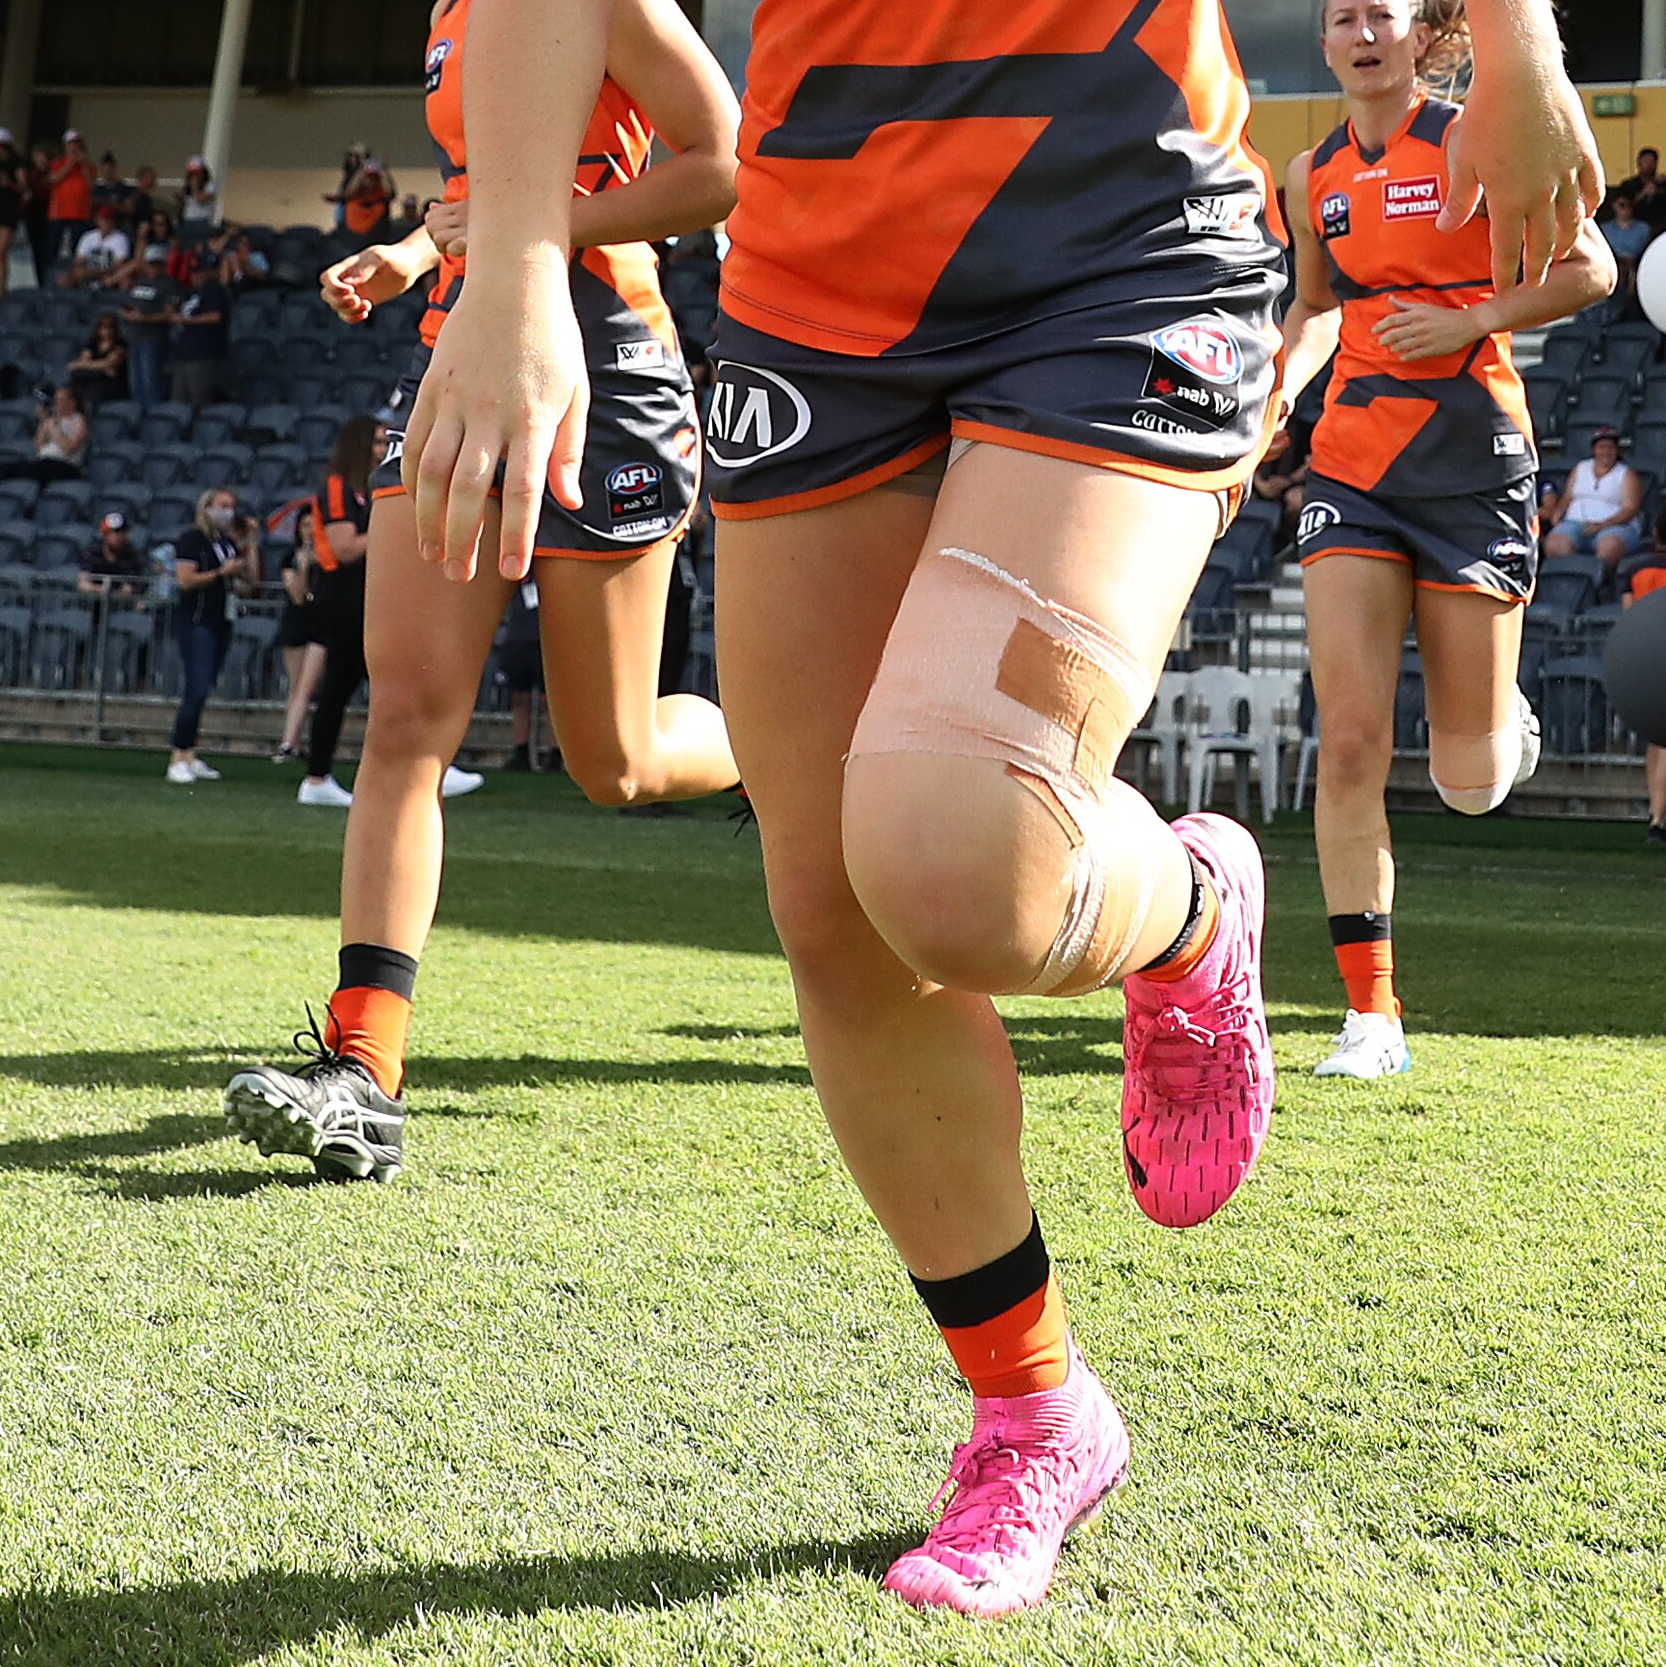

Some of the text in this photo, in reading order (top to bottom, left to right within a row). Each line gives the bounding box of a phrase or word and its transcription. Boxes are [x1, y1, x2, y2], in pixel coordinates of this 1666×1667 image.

[1387, 182, 1435, 200] Harvey
[1322, 197, 1346, 218] AFL
[1385, 199, 1440, 217] Norman
[1163, 328, 1237, 378] AFL
[1176, 384, 1211, 407] nab
[706, 381, 773, 449] KIA
[612, 467, 658, 490] AFL
